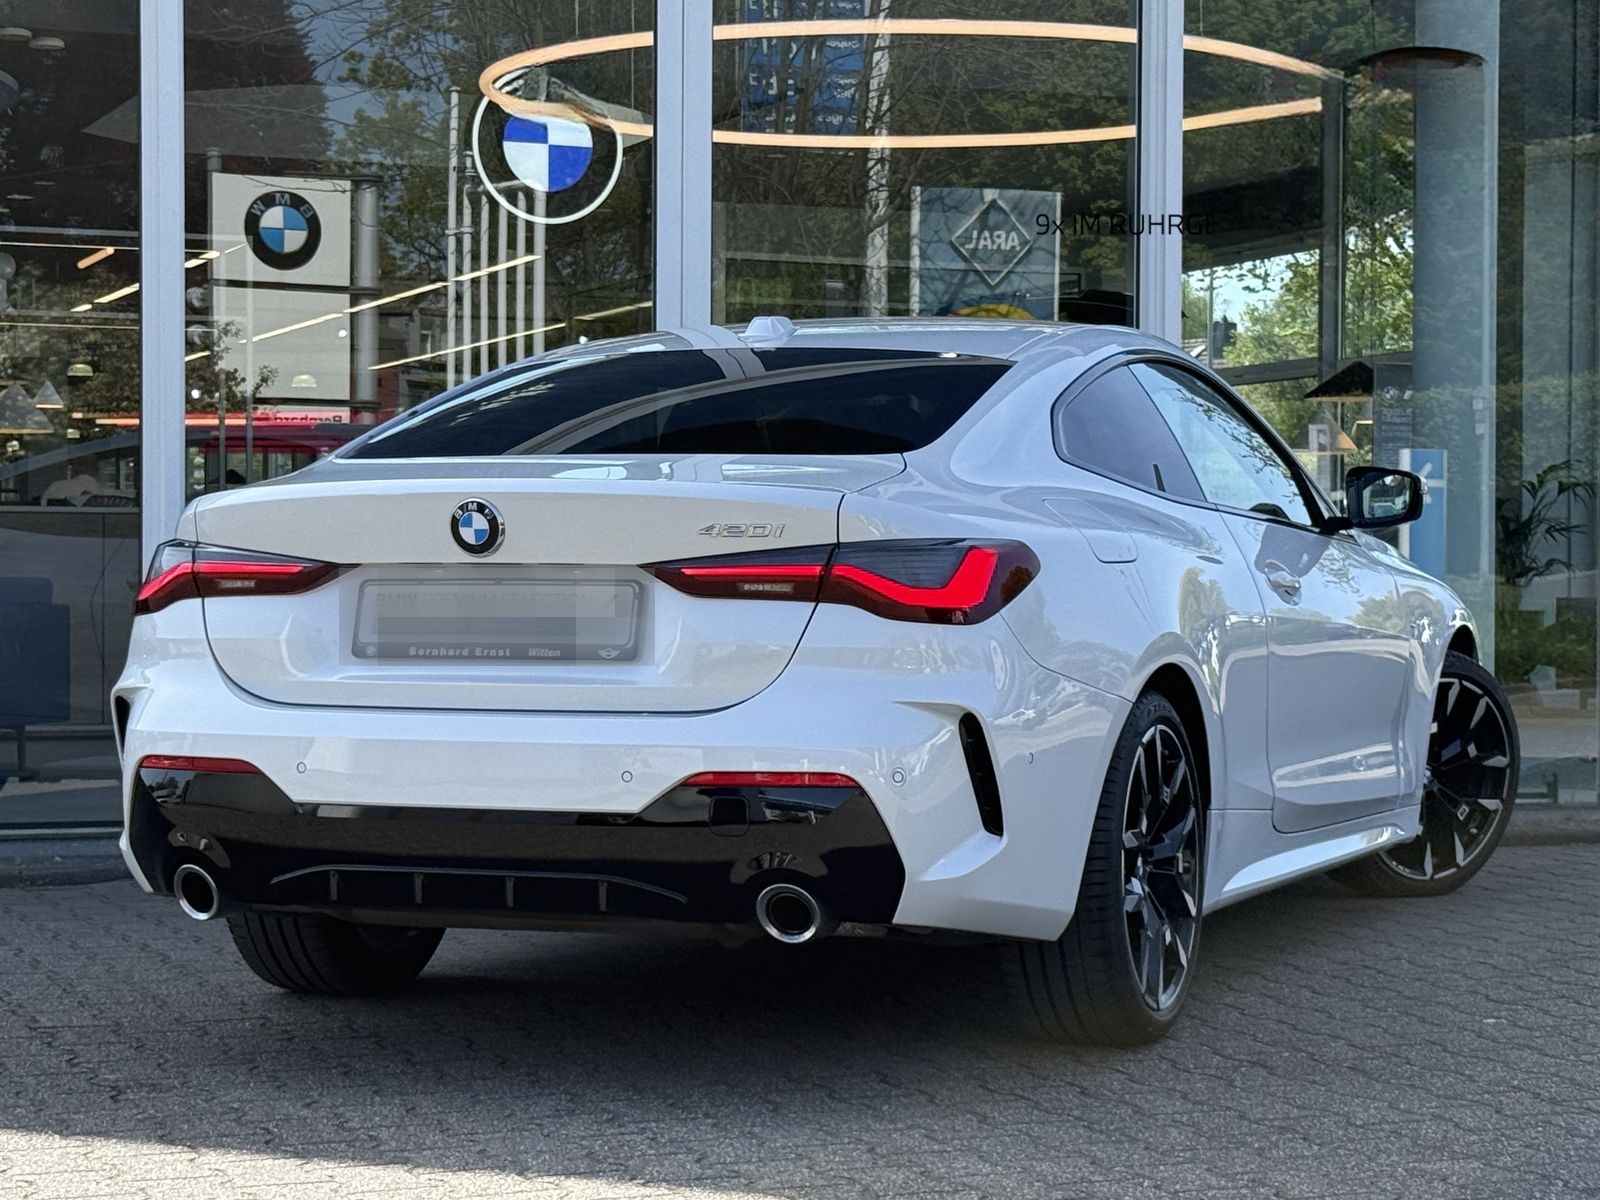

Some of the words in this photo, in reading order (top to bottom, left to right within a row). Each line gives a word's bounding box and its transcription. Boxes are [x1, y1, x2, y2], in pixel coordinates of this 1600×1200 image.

[697, 523, 786, 538] 420i
[376, 592, 418, 608] BMW
[409, 646, 469, 657] Bernhard
[475, 647, 511, 658] Ernst
[528, 647, 562, 658] Witten
